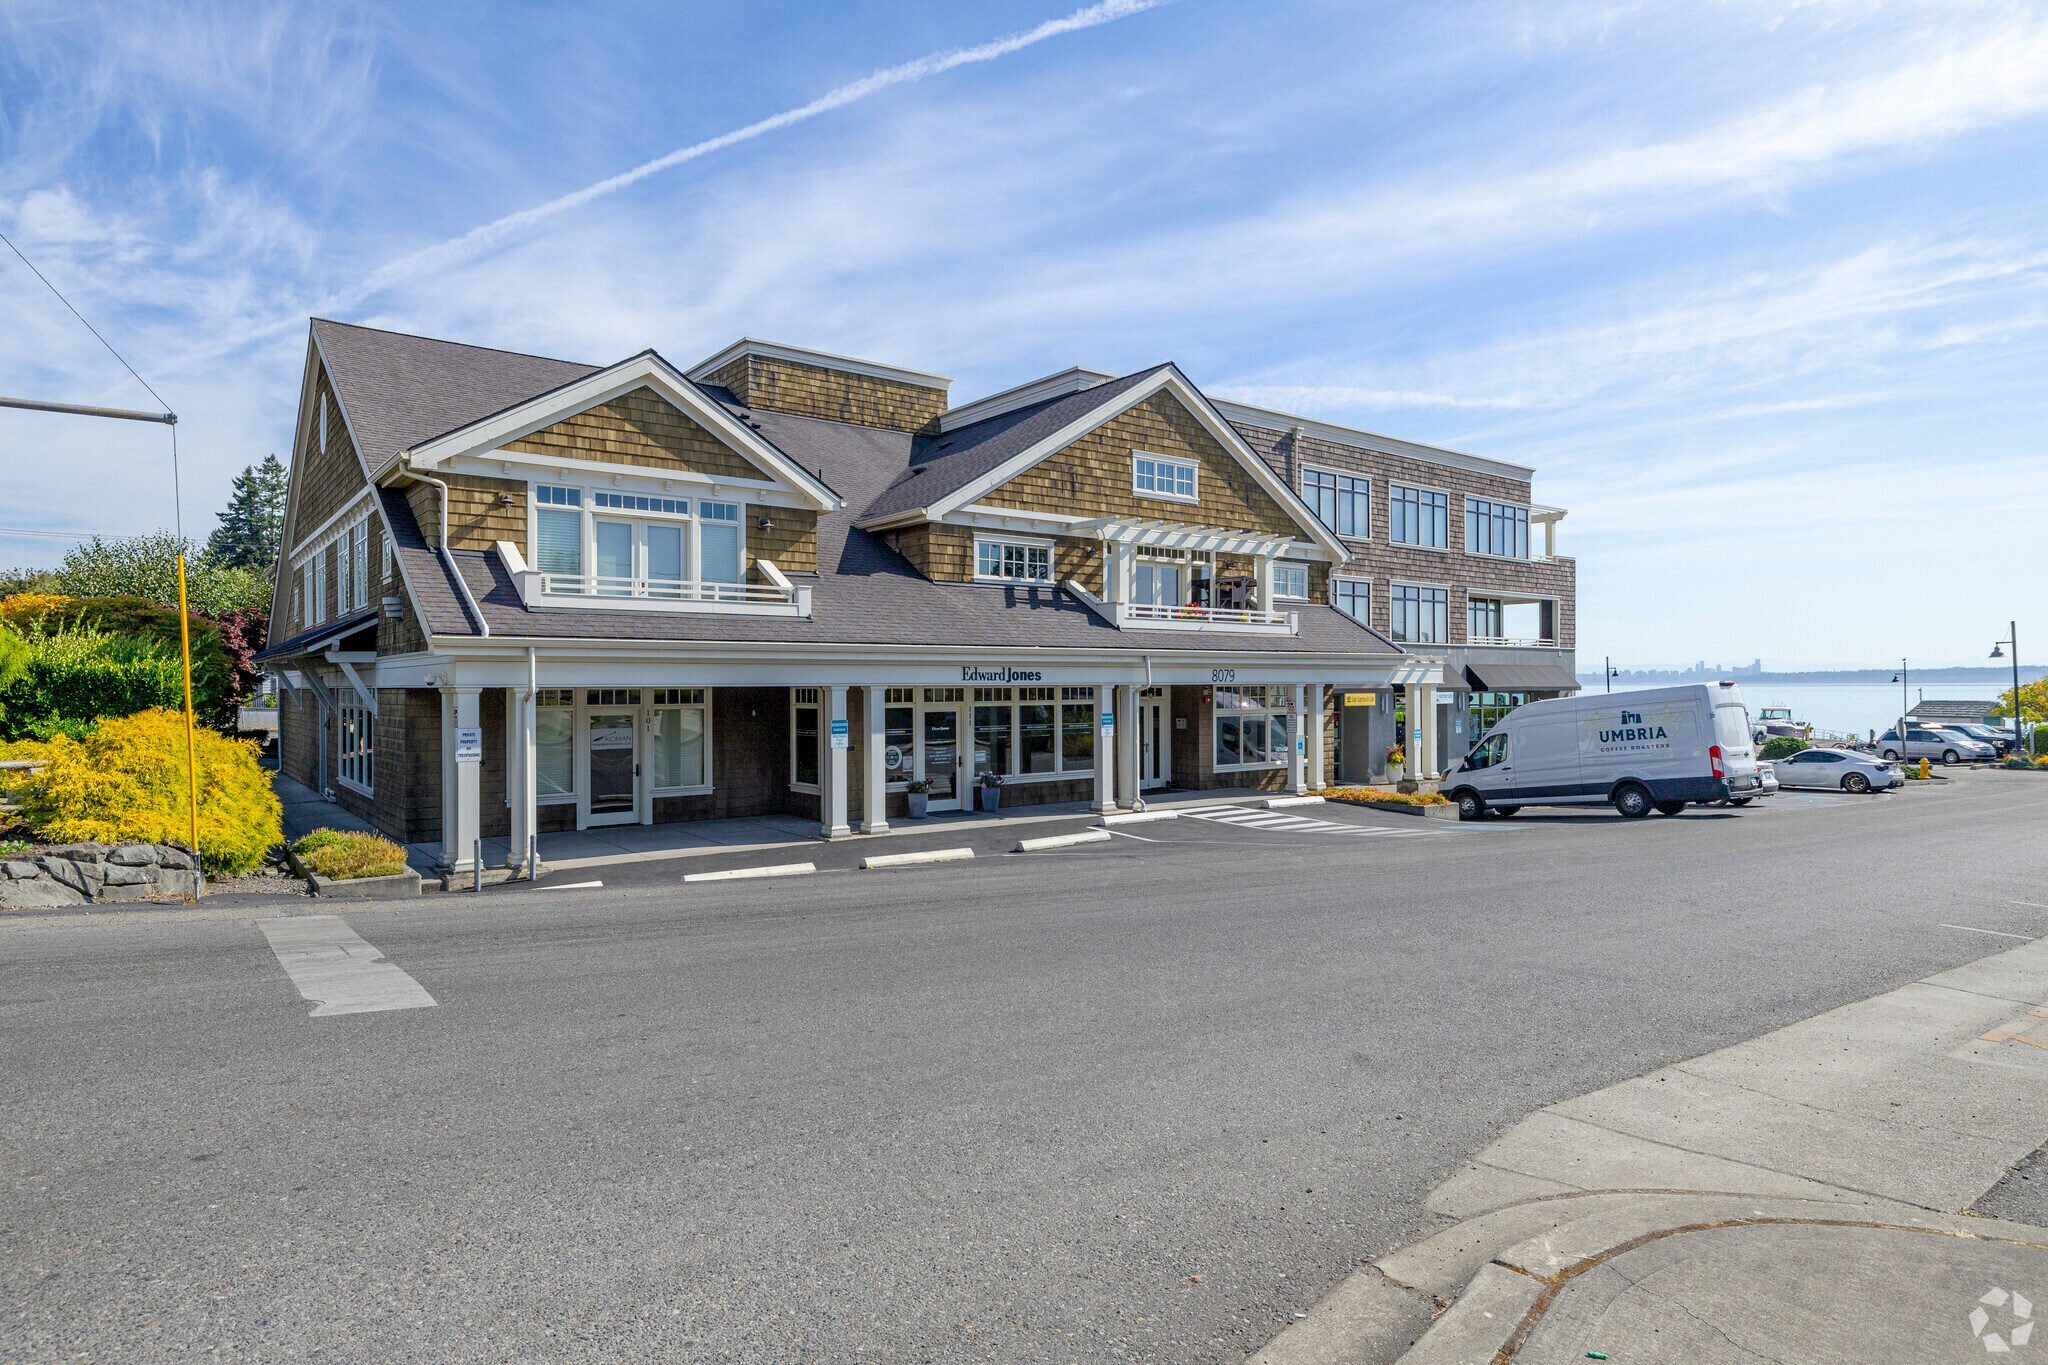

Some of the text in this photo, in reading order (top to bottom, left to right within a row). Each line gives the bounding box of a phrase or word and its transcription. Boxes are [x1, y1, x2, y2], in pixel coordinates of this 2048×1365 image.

[961, 666, 1042, 683] Edward Jones
[1211, 669, 1236, 682] 8079
[1599, 726, 1668, 743] UMBRIA
[1630, 743, 1670, 751] ROASTERS
